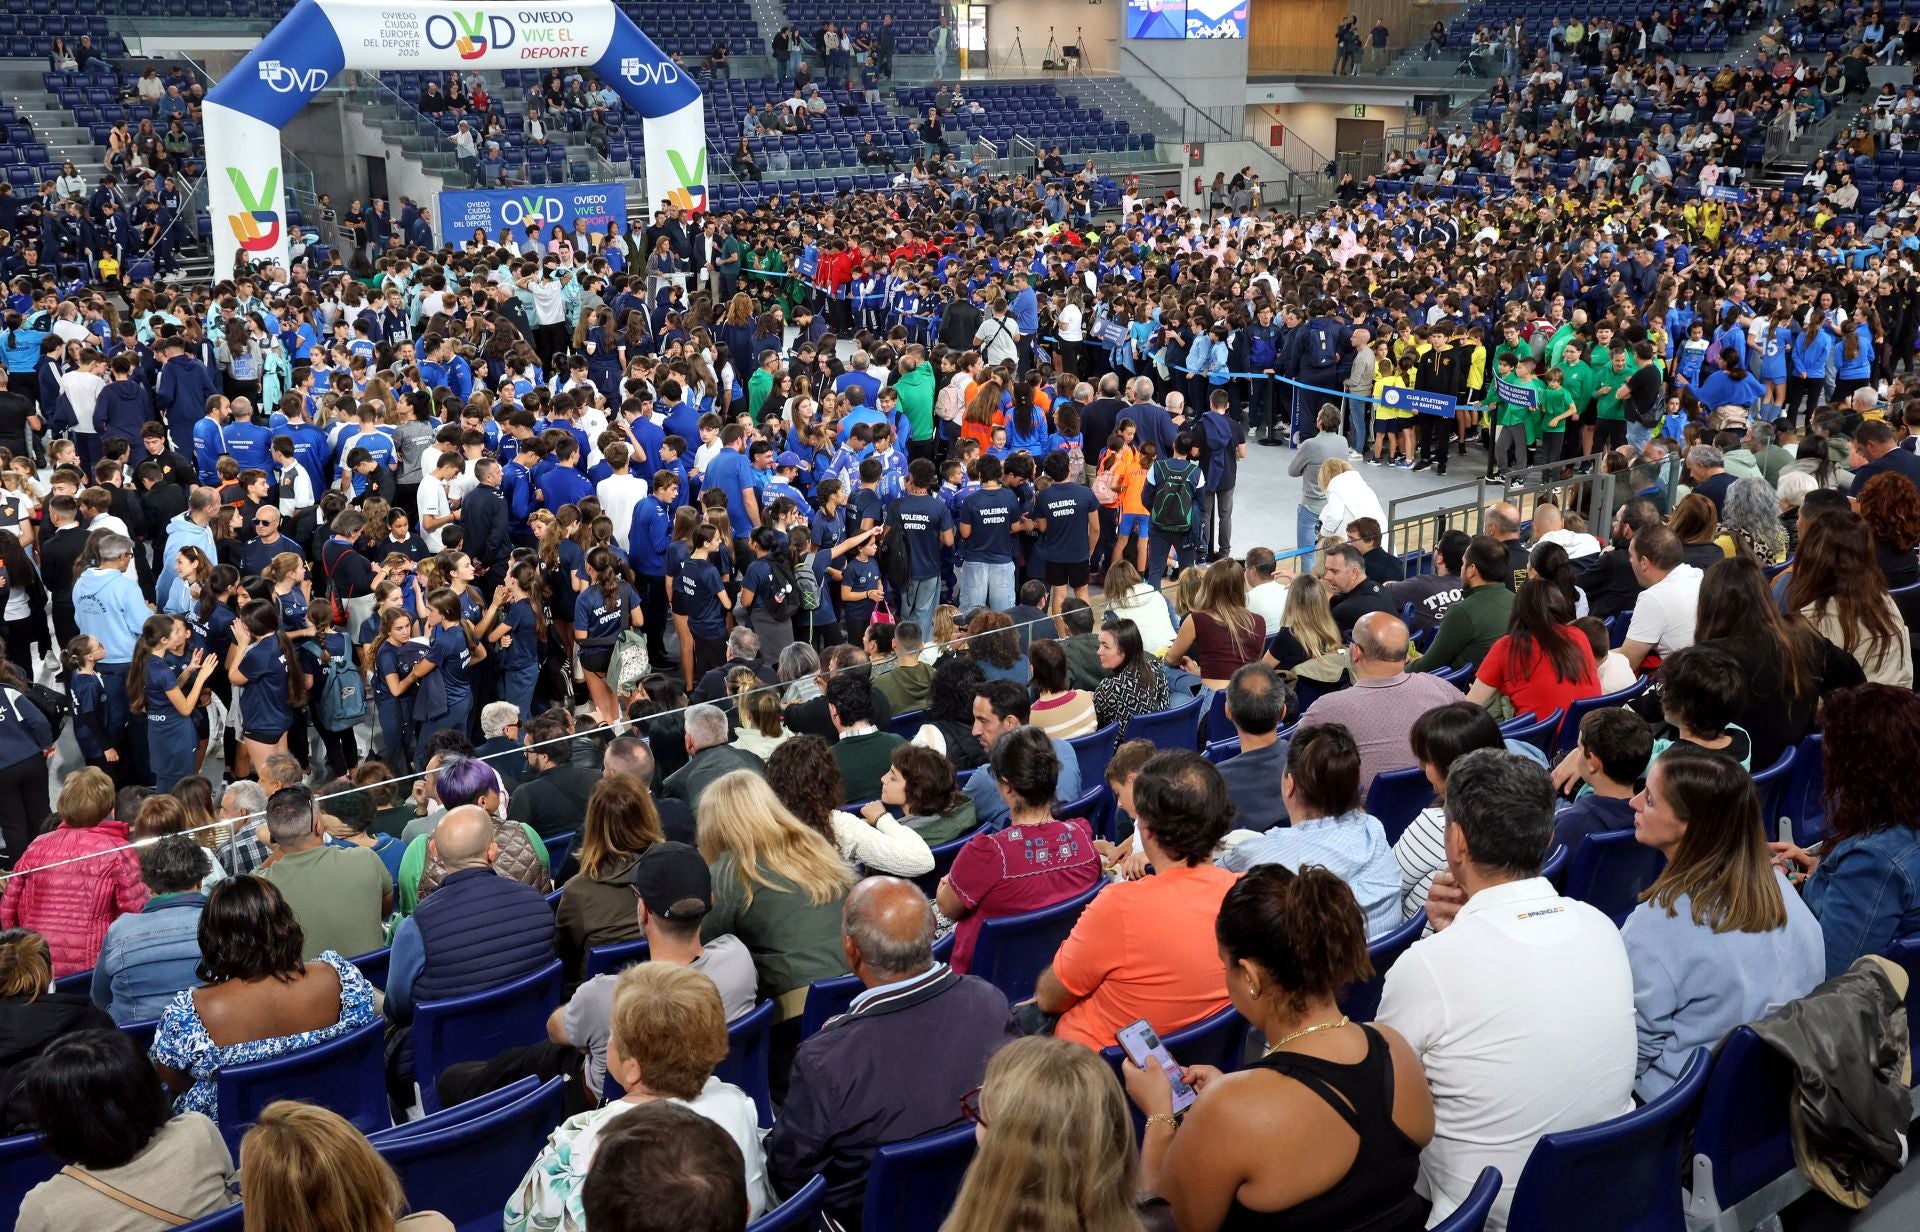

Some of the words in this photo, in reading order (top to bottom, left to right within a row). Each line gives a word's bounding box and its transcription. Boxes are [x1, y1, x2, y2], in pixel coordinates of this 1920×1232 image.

[381, 11, 417, 20] OVIEDO
[518, 11, 574, 24] OVIEDO
[384, 20, 419, 29] CIUDAD
[380, 29, 420, 39] EUROPEA
[521, 28, 555, 43] VIVE
[558, 28, 575, 42] EL
[363, 38, 380, 48] DEL
[382, 38, 420, 48] DEPORTE
[398, 48, 420, 57] 2026
[520, 46, 589, 60] DEPORTE
[627, 62, 678, 86] OVD
[267, 66, 329, 93] OVD
[573, 194, 607, 205] OVIEDO
[467, 207, 491, 215] CIUDAD
[574, 206, 594, 216] VIVE
[596, 205, 606, 215] EL
[464, 213, 492, 221] EUROPEA
[465, 220, 492, 228] DEPORTE
[1762, 337, 1779, 357] 15
[1420, 396, 1449, 406] ATLETISMO
[1419, 402, 1442, 411] SANTINA
[1047, 499, 1077, 510] VOLEIBOL
[979, 507, 1009, 517] VOLEIBOL
[1052, 508, 1075, 518] OVIEDO
[901, 513, 930, 523] VOLEIBOL
[983, 516, 1005, 525] OVIEDO
[904, 522, 926, 531] OVIEDO
[1423, 588, 1465, 610] TRO
